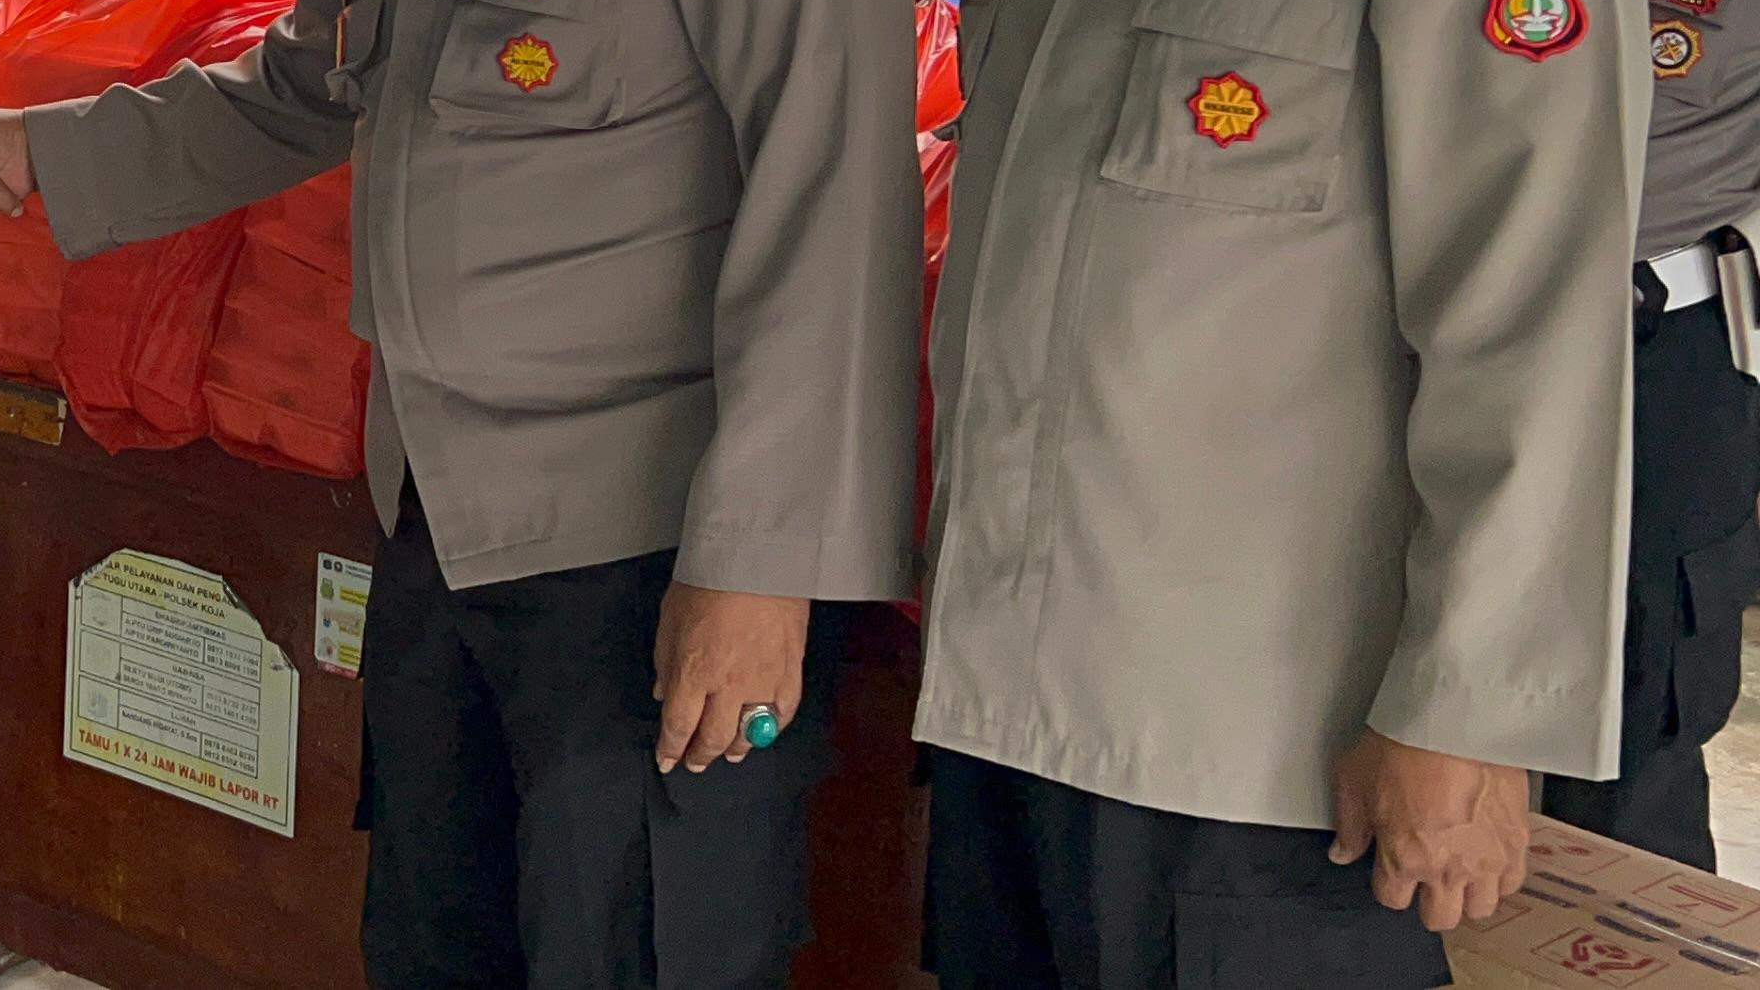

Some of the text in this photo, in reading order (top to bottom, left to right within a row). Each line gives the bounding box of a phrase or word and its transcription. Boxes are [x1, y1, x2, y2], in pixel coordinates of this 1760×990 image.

[103, 572, 127, 588] TUGU
[128, 580, 157, 597] UTARA
[163, 591, 199, 609] POLSEK
[201, 603, 225, 618] KOJA
[123, 564, 174, 588] PELAYANAN
[176, 580, 195, 594] DAN
[78, 729, 280, 810] TAMU 1 X 24 JAM WAJIB LAPOR RT
